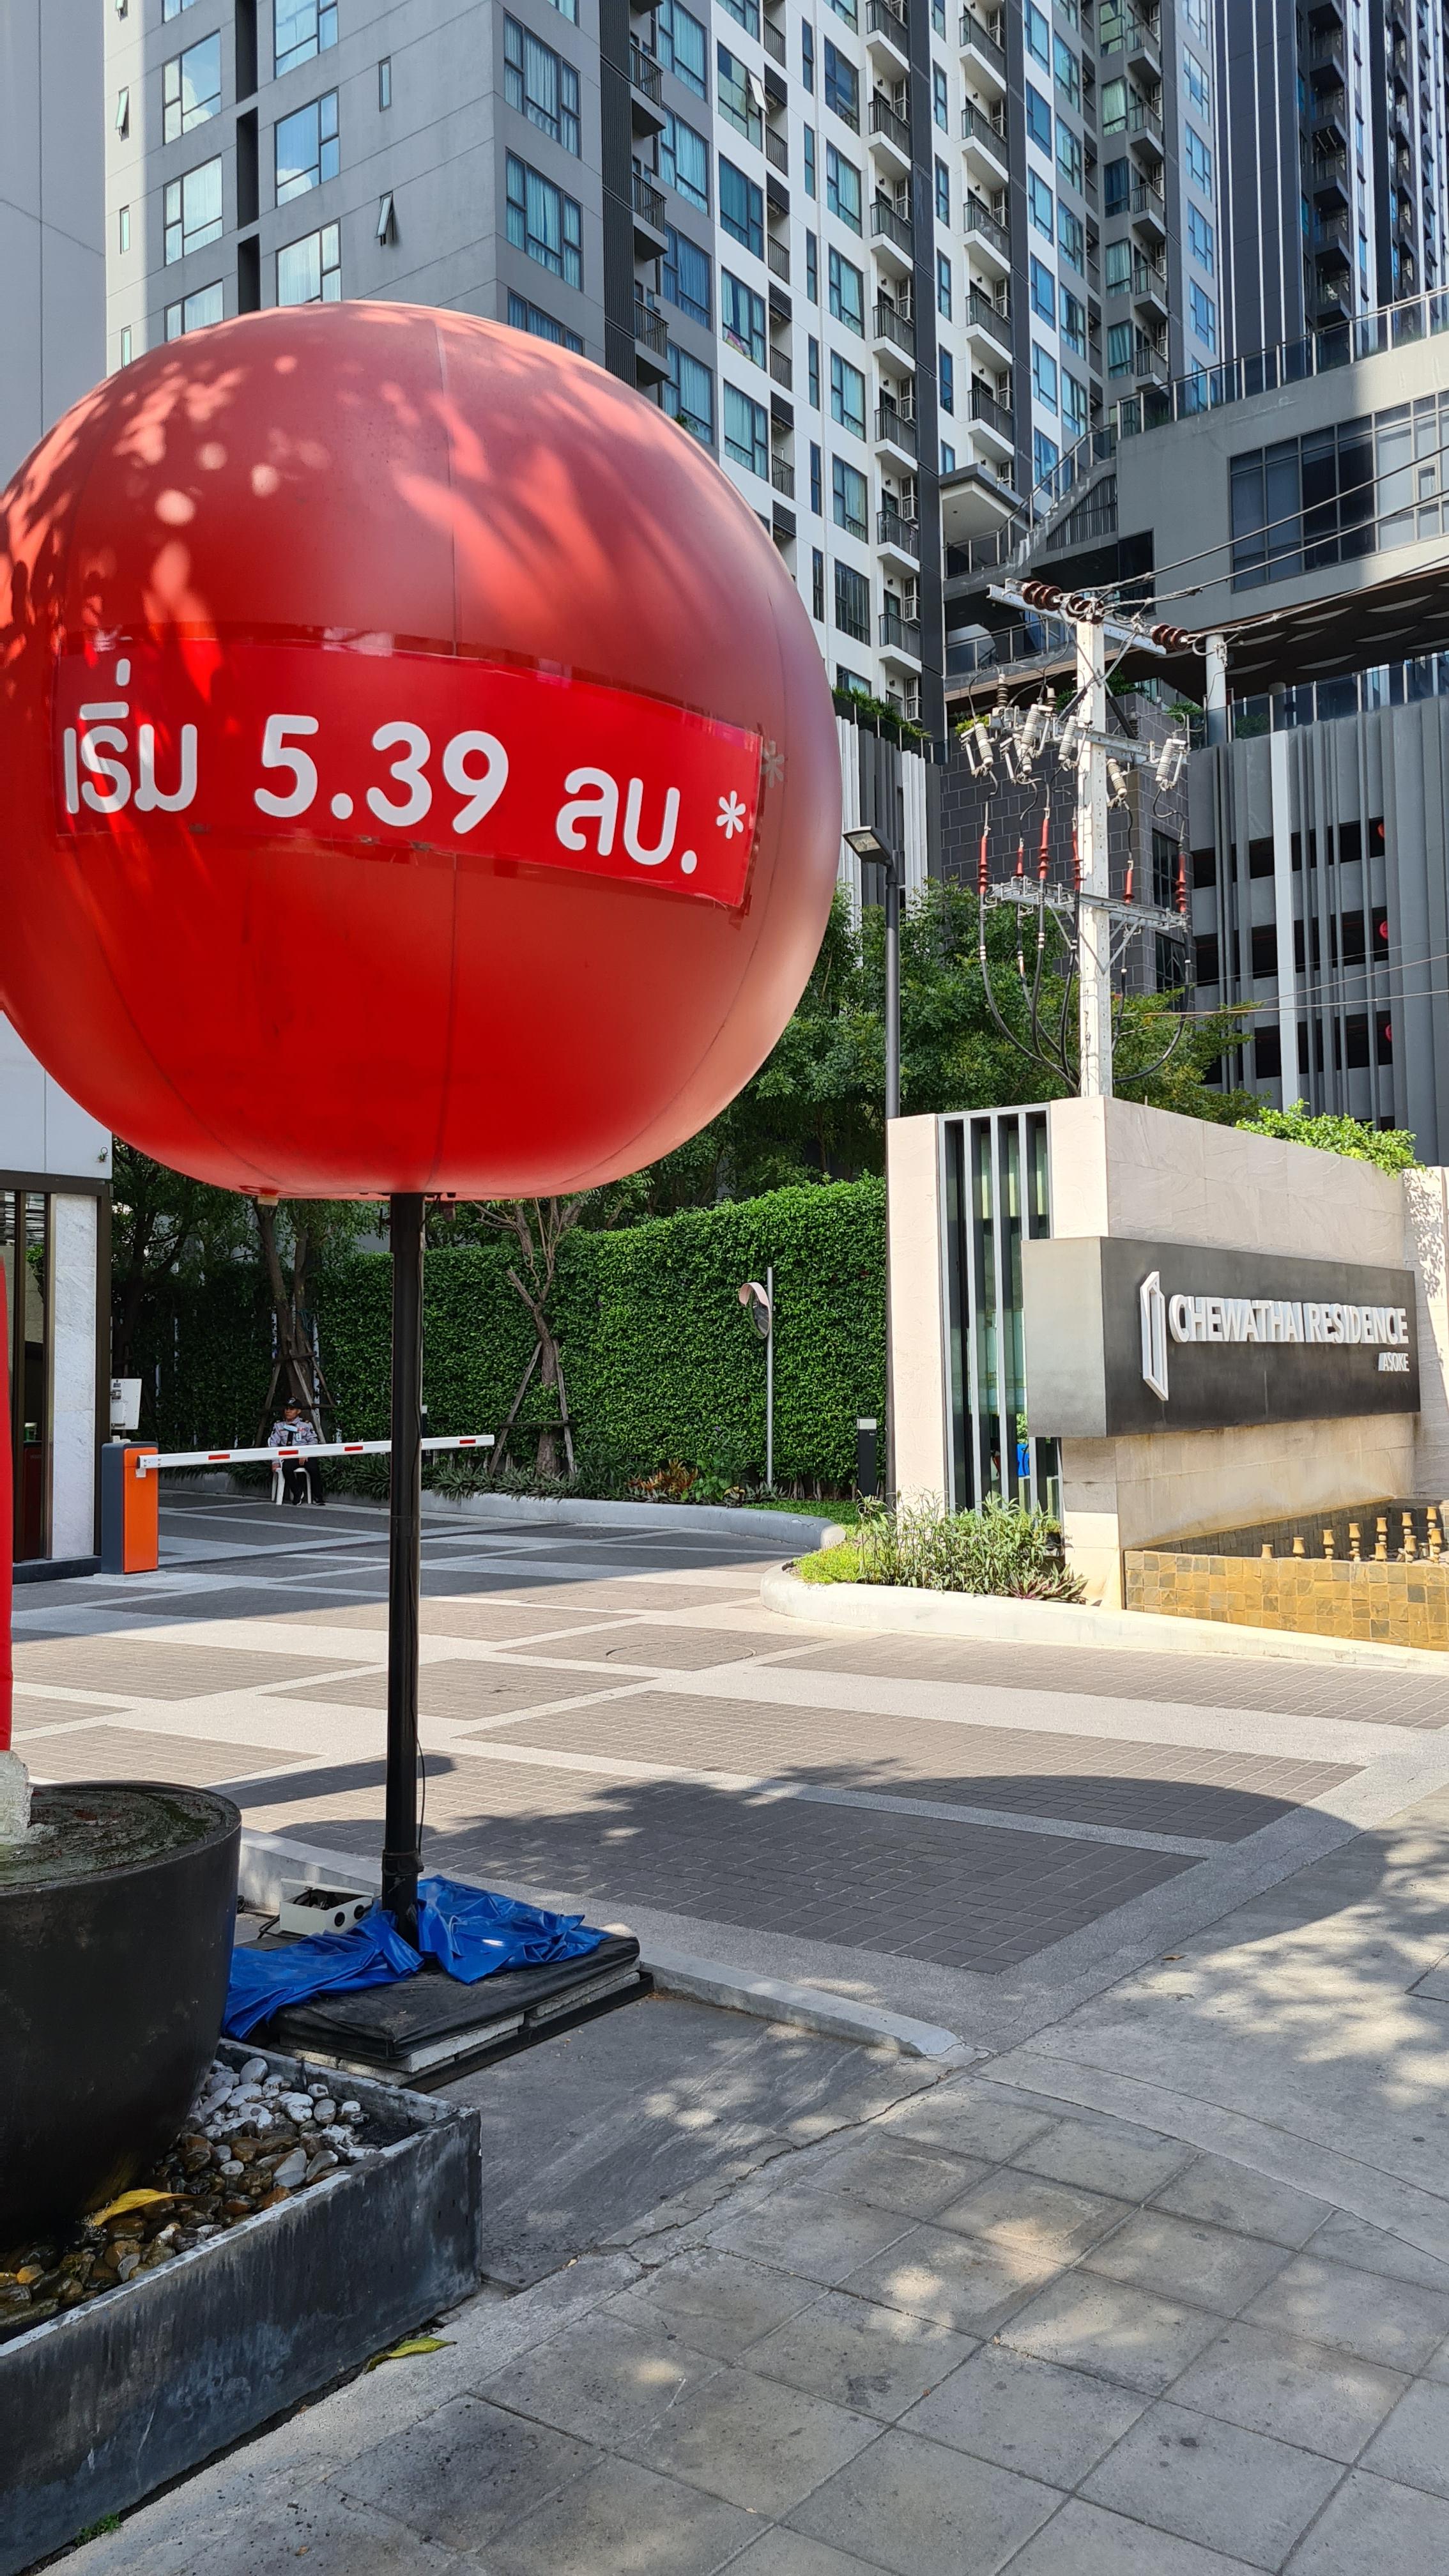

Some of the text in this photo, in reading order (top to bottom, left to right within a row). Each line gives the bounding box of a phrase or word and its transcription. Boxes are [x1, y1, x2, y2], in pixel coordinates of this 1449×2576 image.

[64, 659, 197, 815] เริ่ม
[254, 714, 509, 834] 5.39
[1169, 1294, 1409, 1345] CHEWATHAI RESIDENCE
[1378, 1351, 1410, 1372] ASOKE
